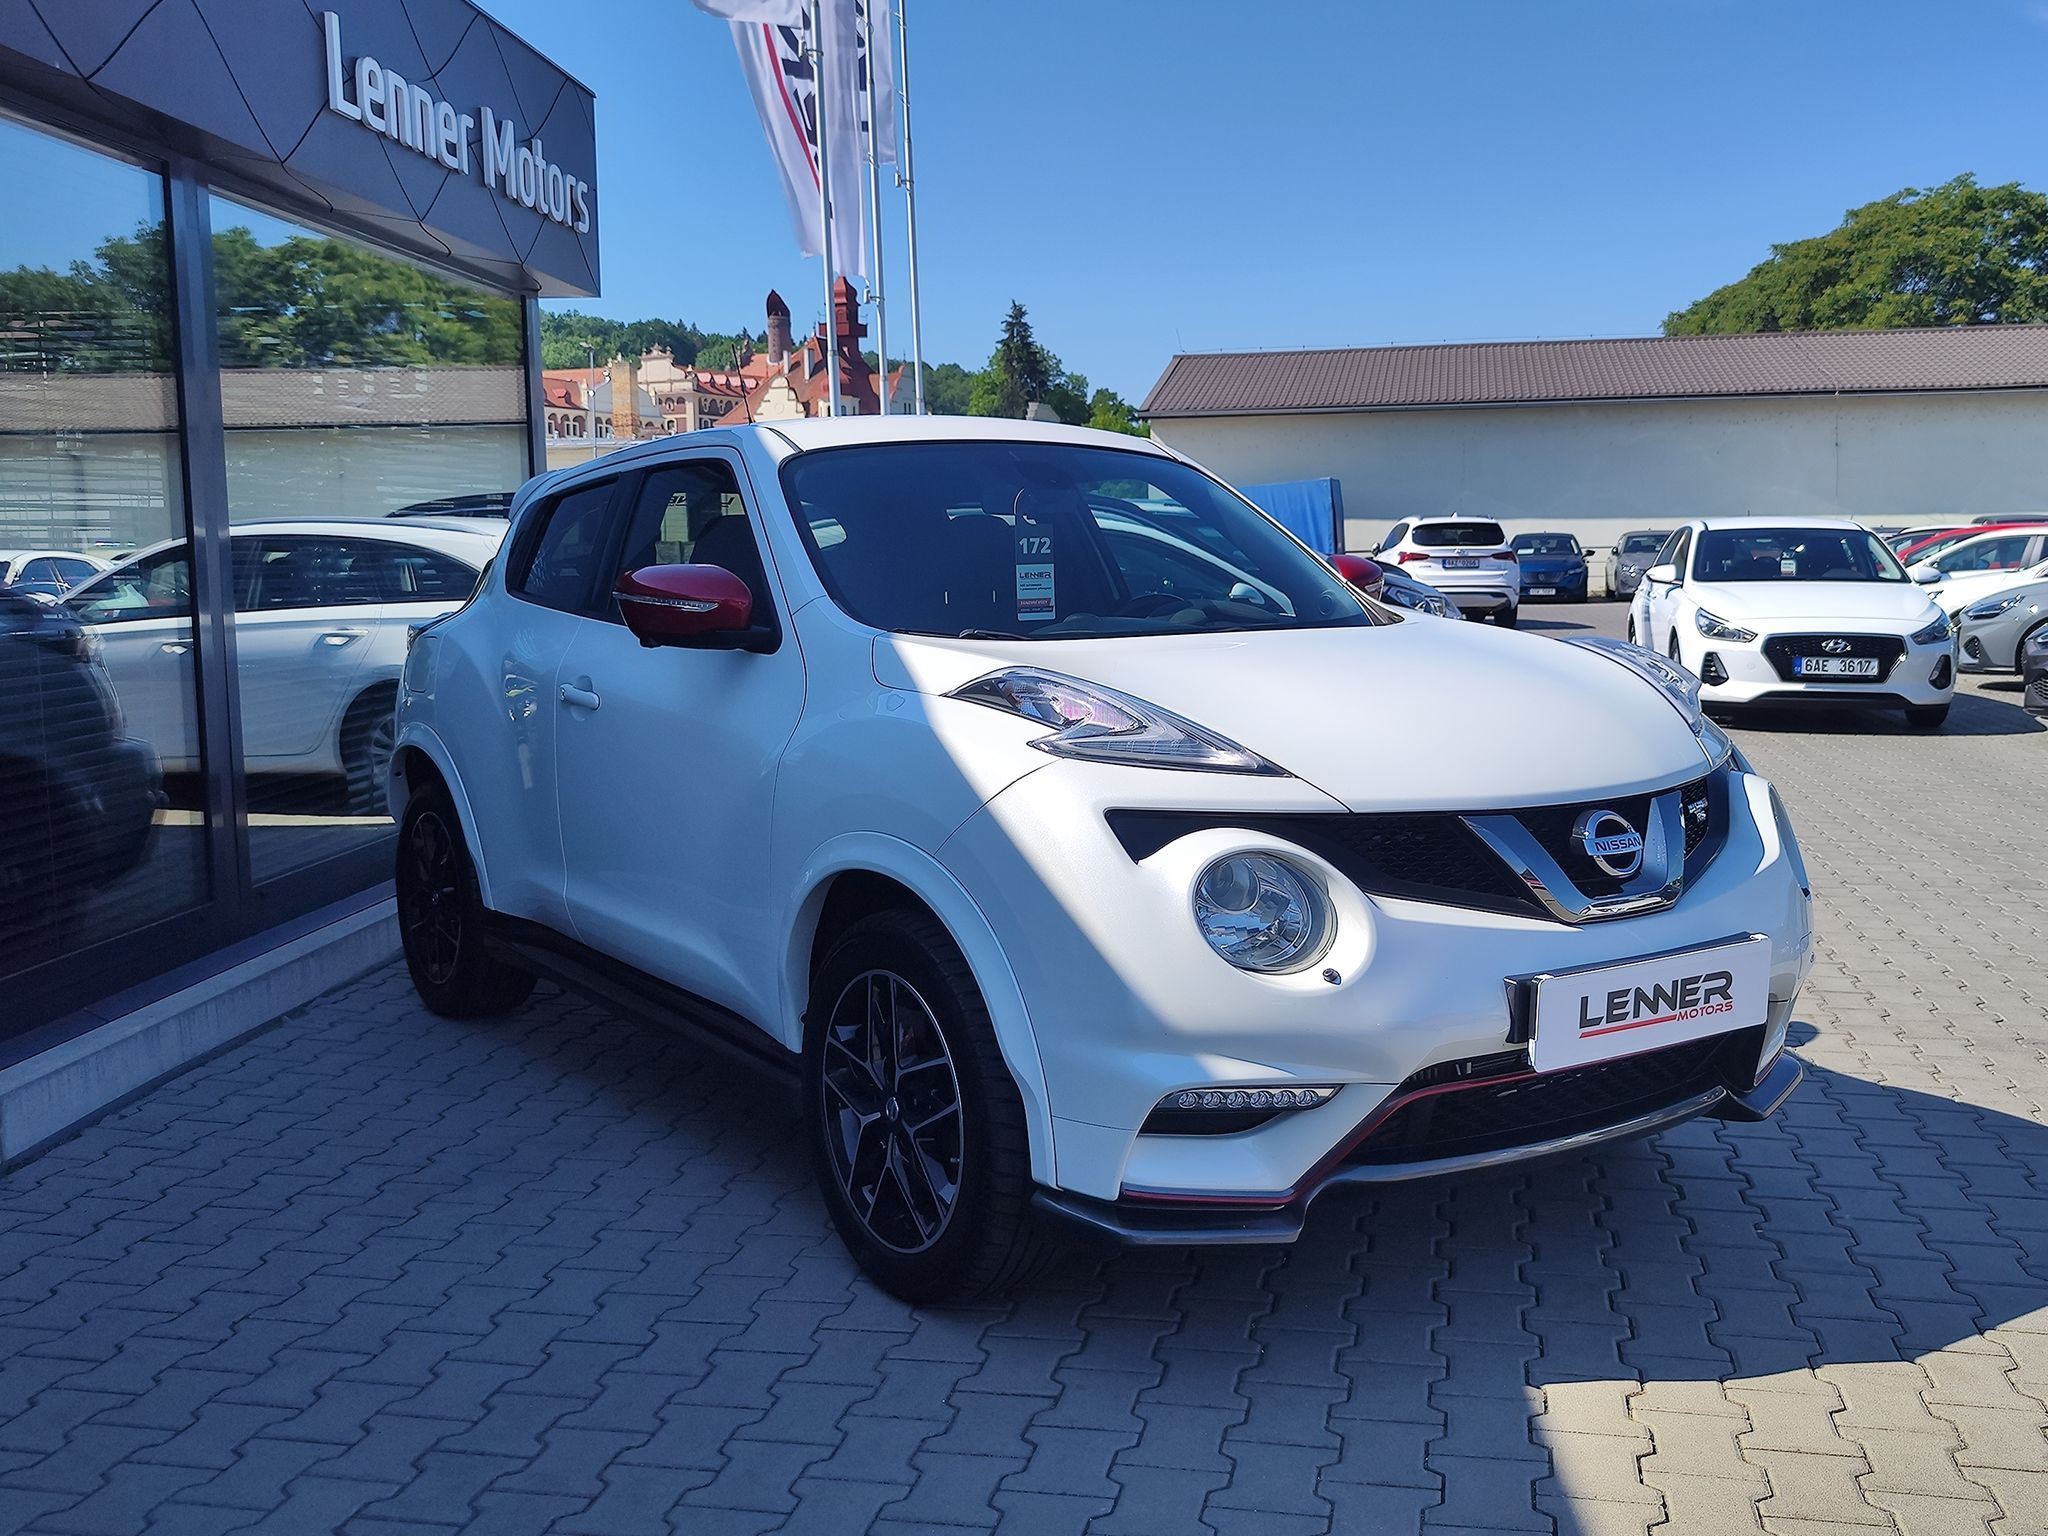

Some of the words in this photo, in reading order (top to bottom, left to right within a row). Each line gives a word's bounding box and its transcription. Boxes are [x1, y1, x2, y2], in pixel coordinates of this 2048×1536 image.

[324, 11, 474, 175] Lenner
[480, 106, 591, 234] Motors
[1019, 537, 1051, 554] 172
[1019, 571, 1051, 579] LENNER
[1805, 659, 1829, 673] 6AE
[1839, 659, 1871, 673] 3617
[1594, 836, 1642, 852] NISSAN
[1579, 970, 1733, 1029] LENNER
[1676, 1001, 1734, 1021] MOTORS
